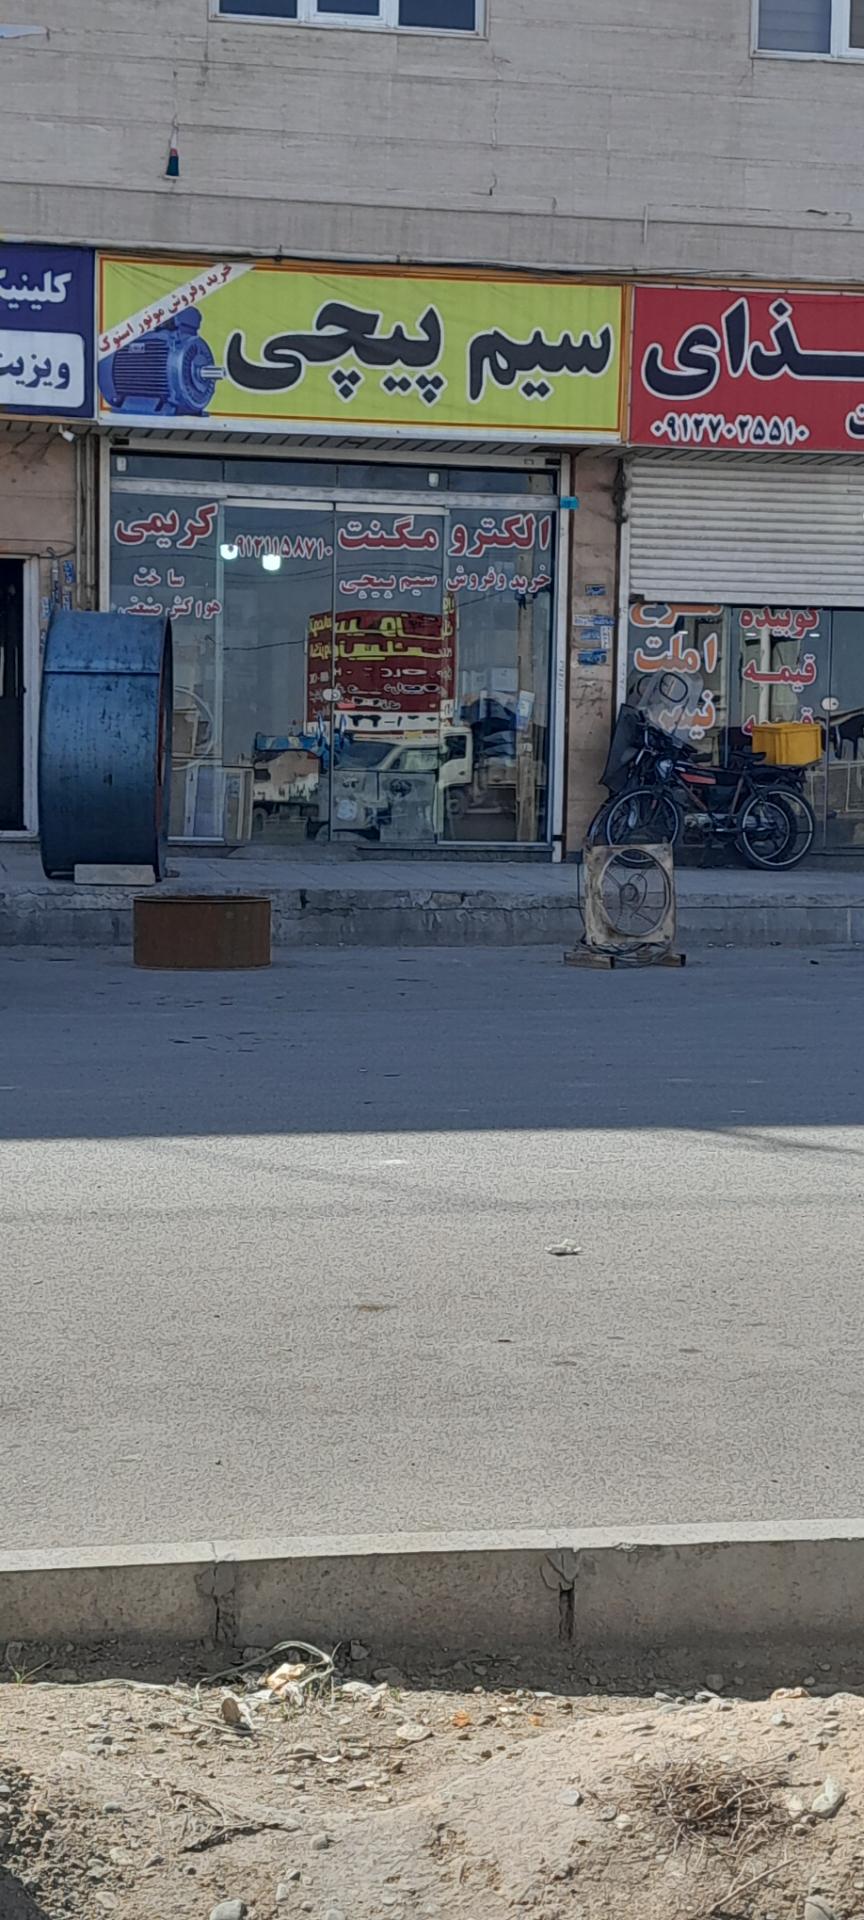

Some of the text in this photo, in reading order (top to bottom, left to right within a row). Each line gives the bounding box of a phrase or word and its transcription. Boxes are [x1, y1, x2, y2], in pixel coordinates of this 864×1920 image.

[206, 262, 233, 286] خرید
[99, 322, 134, 352] استوک
[138, 308, 164, 333] موتور
[225, 301, 613, 405] سیم پیچی
[641, 297, 864, 400] ذای
[114, 503, 218, 548] کریمی
[338, 513, 552, 557] الکترو مگنت
[339, 573, 396, 600] پیچی
[399, 574, 438, 597] سیم
[509, 564, 552, 593] خرید
[634, 632, 717, 674] املت
[742, 654, 816, 692] قیمه
